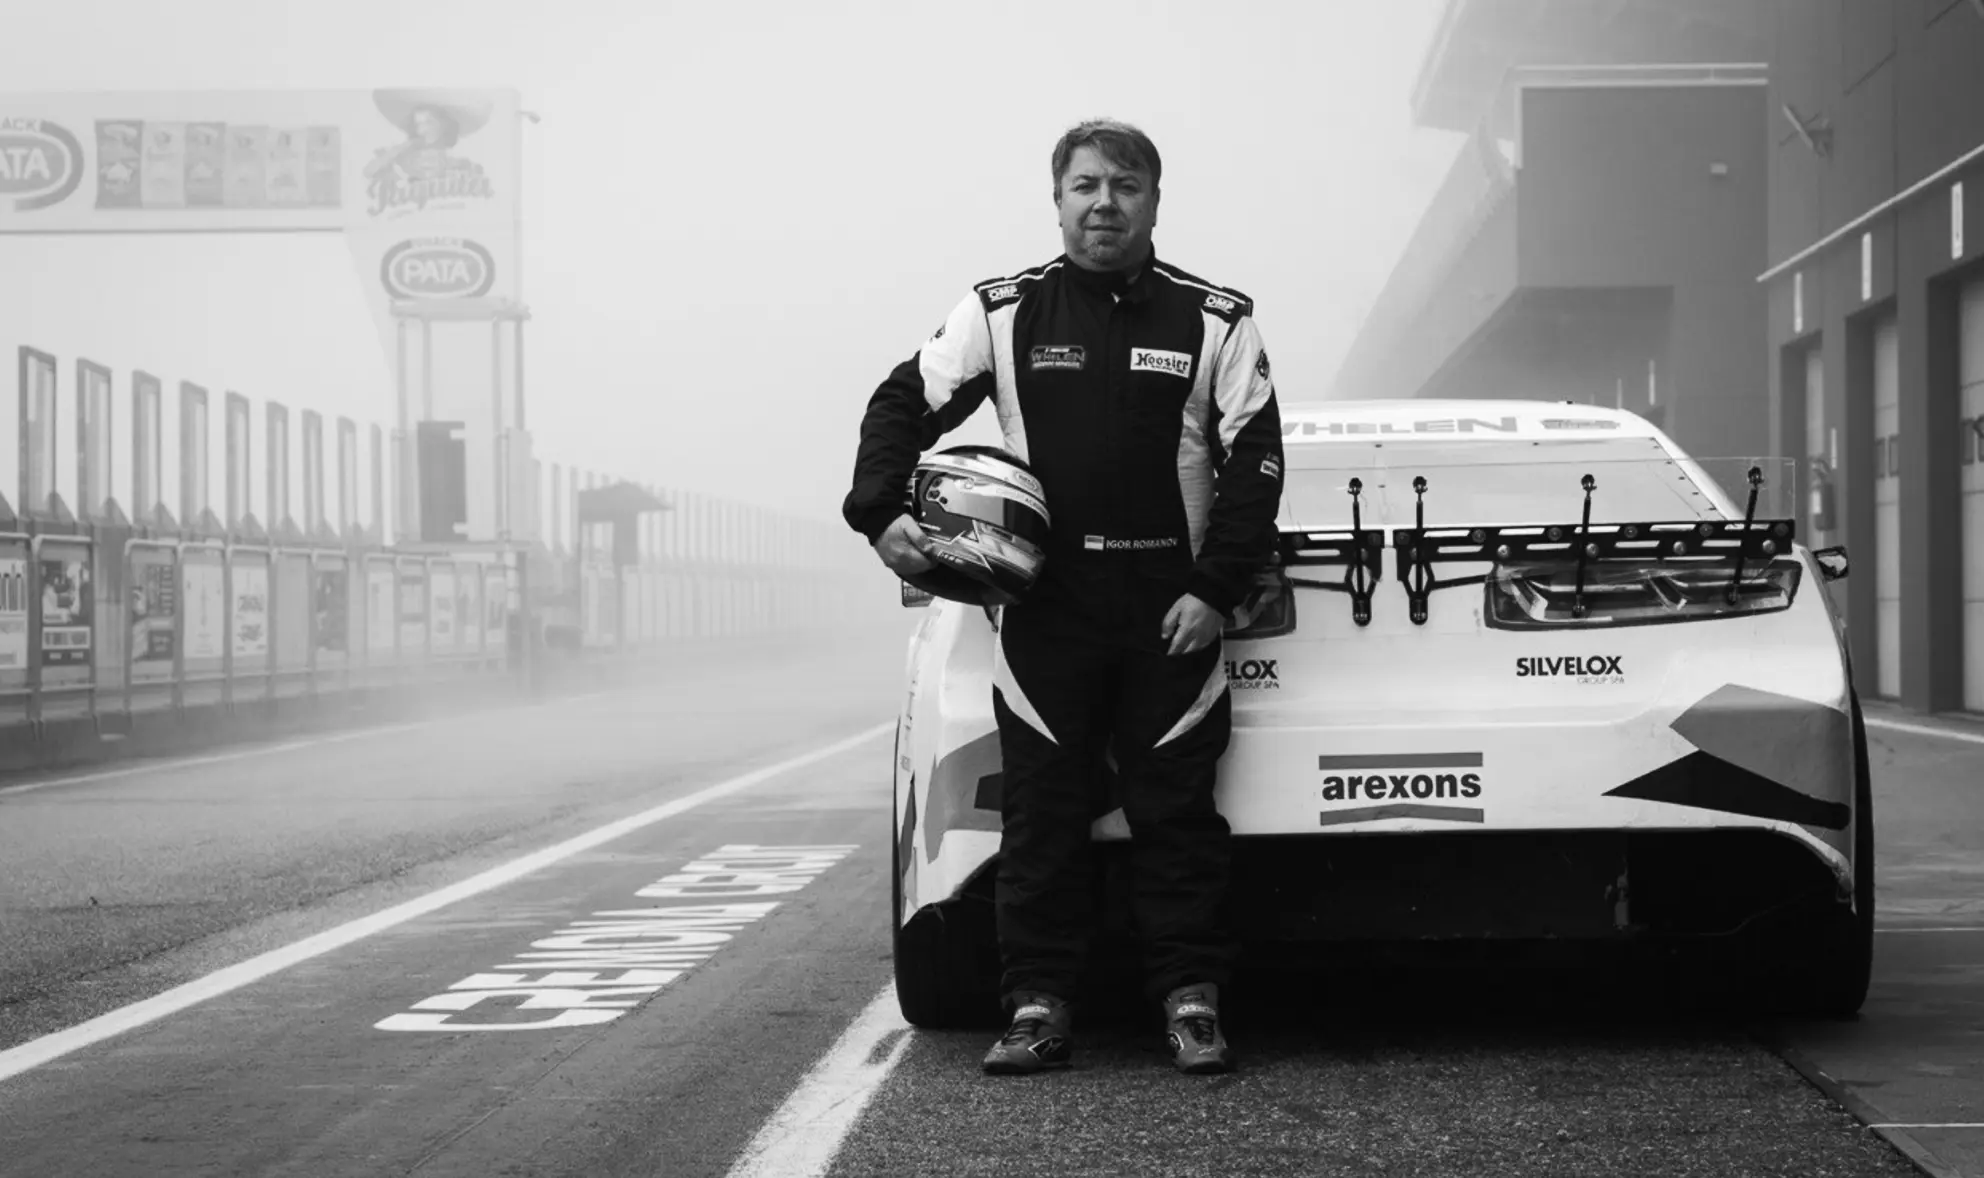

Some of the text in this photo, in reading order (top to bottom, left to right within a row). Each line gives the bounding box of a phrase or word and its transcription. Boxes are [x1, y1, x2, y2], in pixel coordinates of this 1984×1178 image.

[403, 258, 470, 285] PATA
[1106, 539, 1131, 549] IGOR
[1516, 655, 1623, 676] SILVELOX
[1322, 773, 1482, 801] arexons
